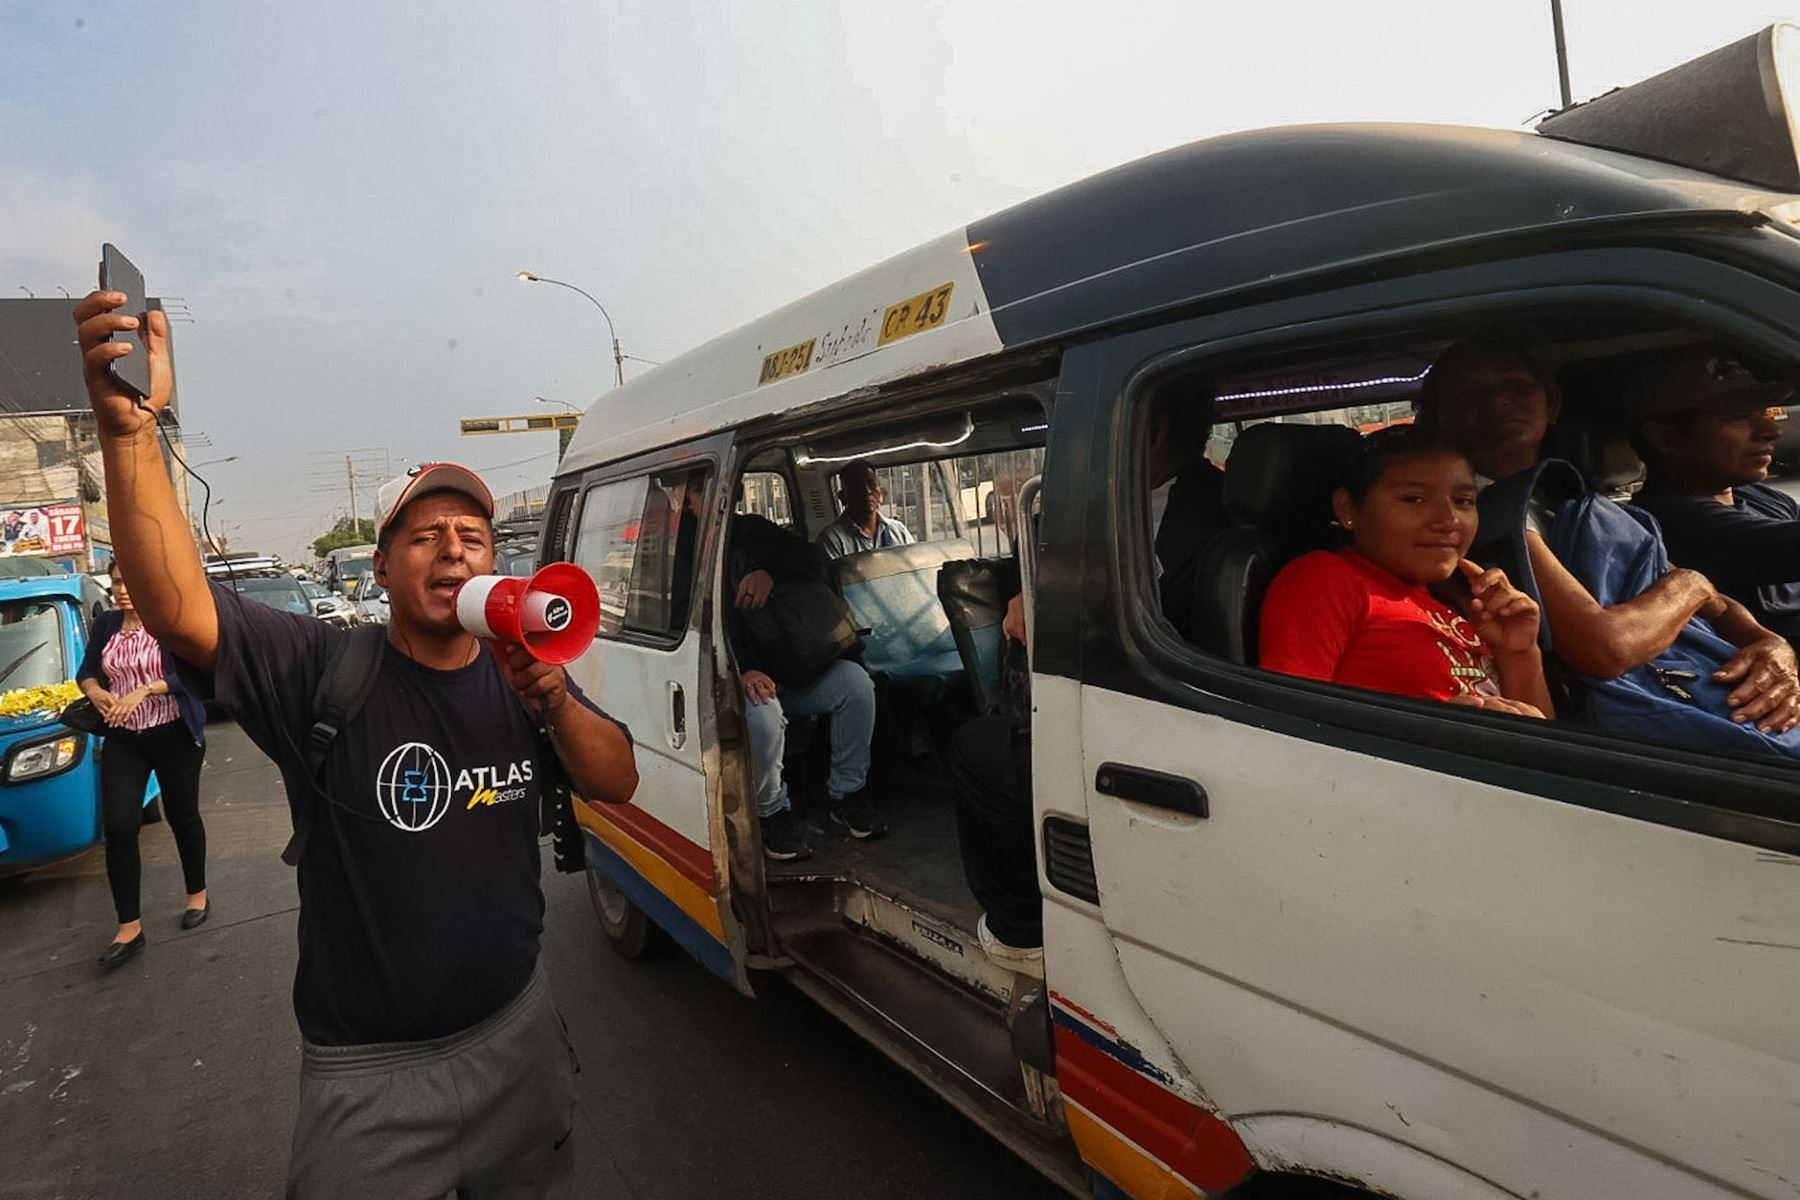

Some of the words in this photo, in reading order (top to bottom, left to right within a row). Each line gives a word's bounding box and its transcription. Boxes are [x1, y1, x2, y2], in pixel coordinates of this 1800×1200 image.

[914, 287, 951, 329] 43
[50, 514, 80, 536] 17
[454, 760, 533, 792] ATLAS
[466, 784, 526, 810] Masters
